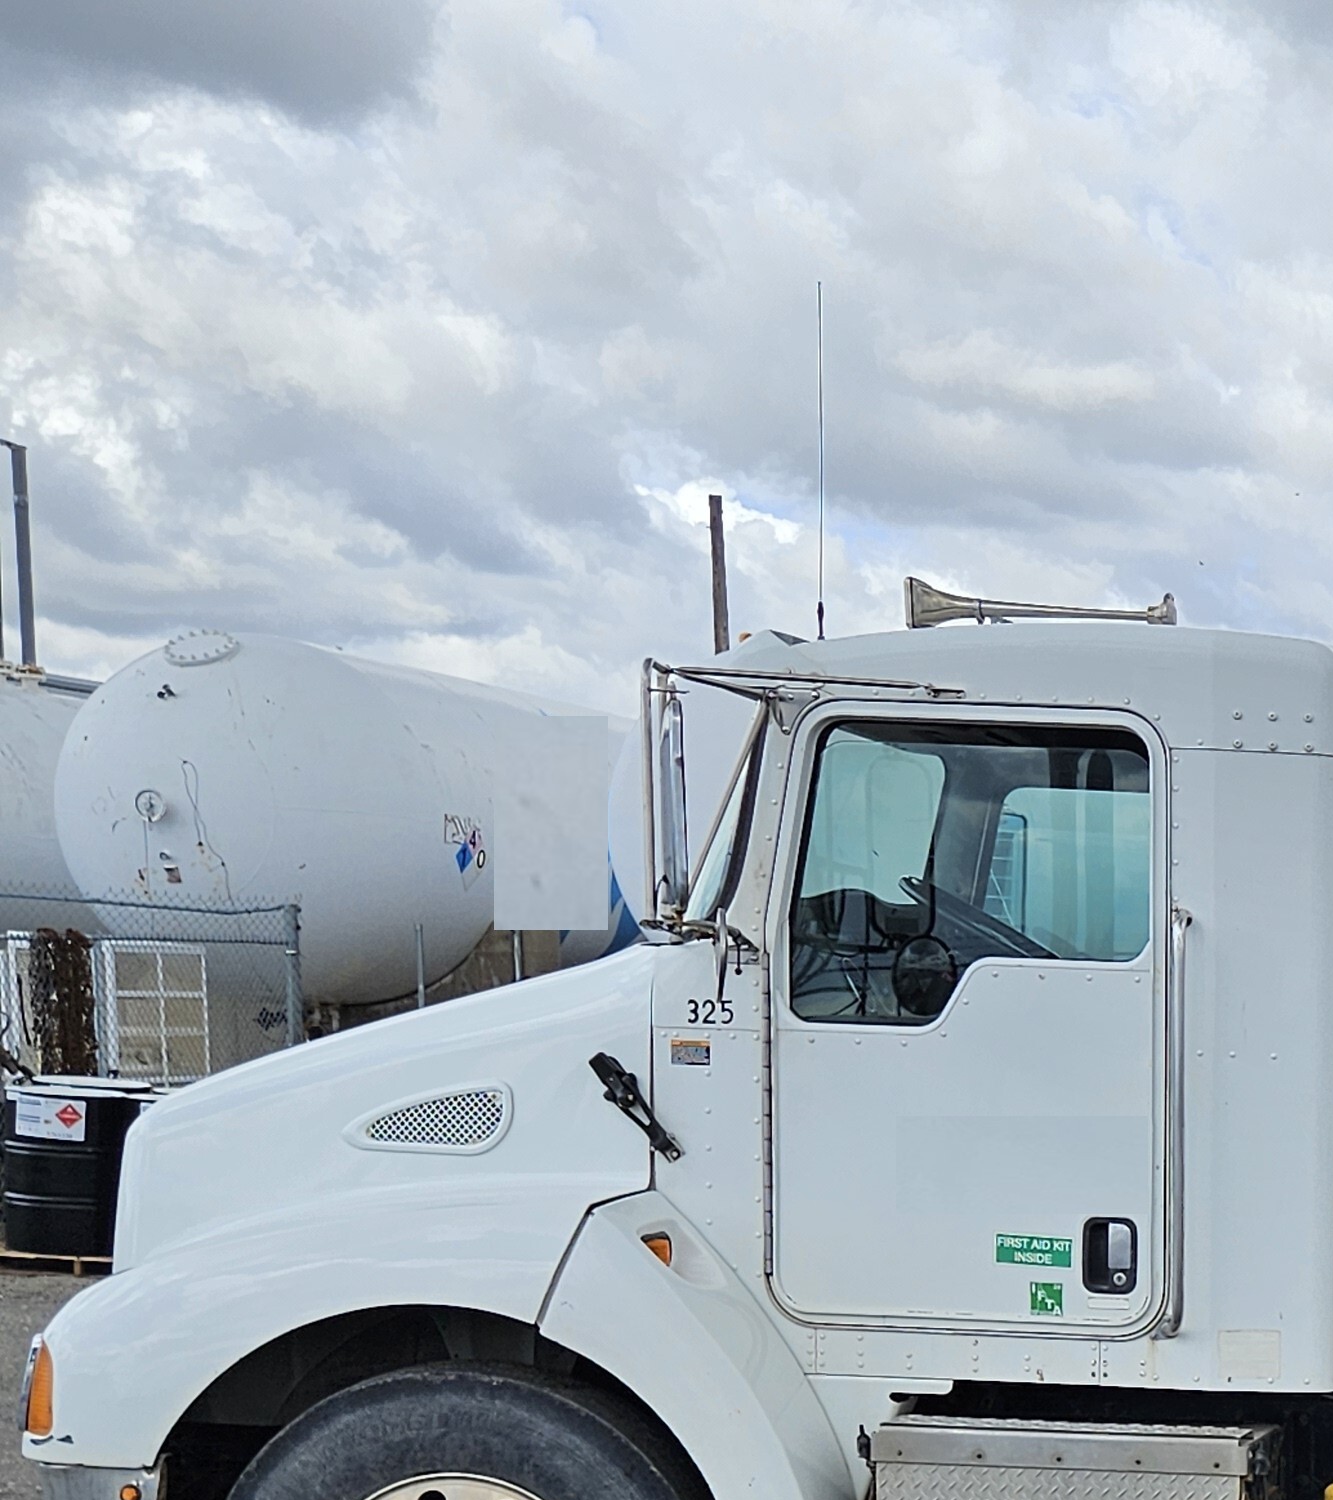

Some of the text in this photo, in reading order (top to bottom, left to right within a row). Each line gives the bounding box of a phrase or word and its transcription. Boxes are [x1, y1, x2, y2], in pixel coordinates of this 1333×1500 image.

[687, 999, 734, 1025] 325
[996, 1236, 1072, 1252] FIRST AID KIT
[1013, 1252, 1053, 1265] INSIDE
